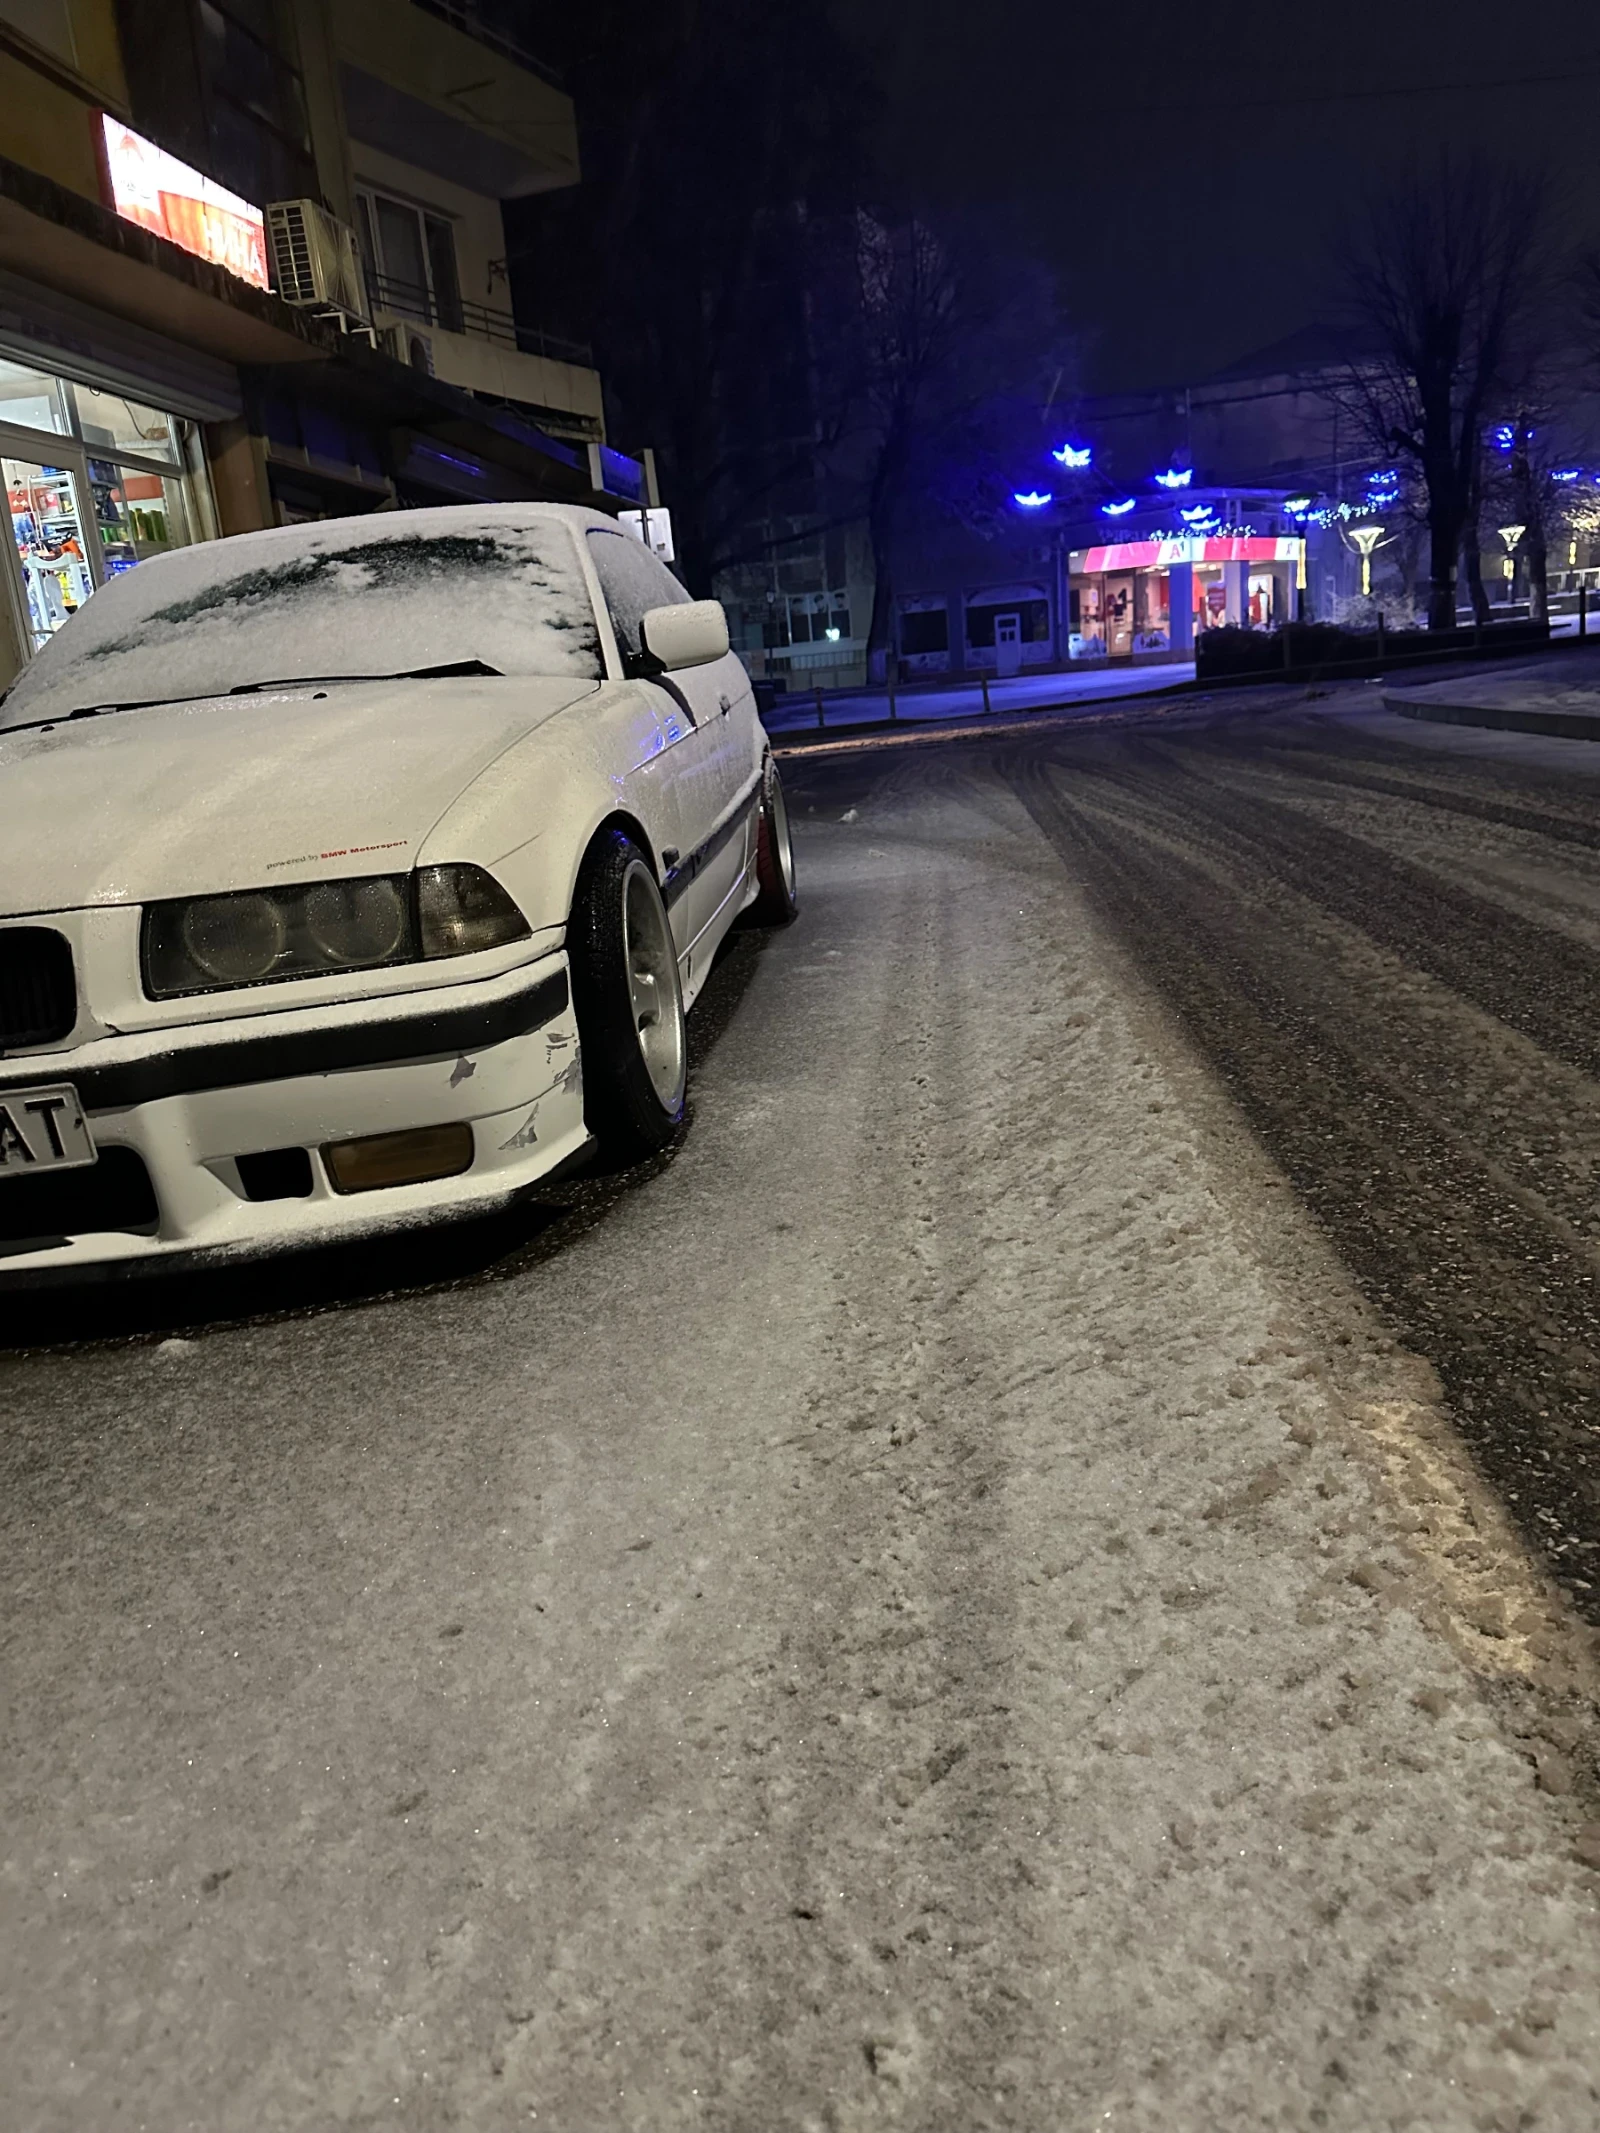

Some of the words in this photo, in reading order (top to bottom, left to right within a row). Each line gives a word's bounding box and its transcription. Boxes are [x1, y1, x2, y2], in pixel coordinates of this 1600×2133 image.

[266, 856, 306, 870] powered
[308, 854, 319, 863] by
[320, 849, 347, 859] BMW
[350, 839, 408, 854] Motorsport
[0, 1097, 66, 1162] AT
